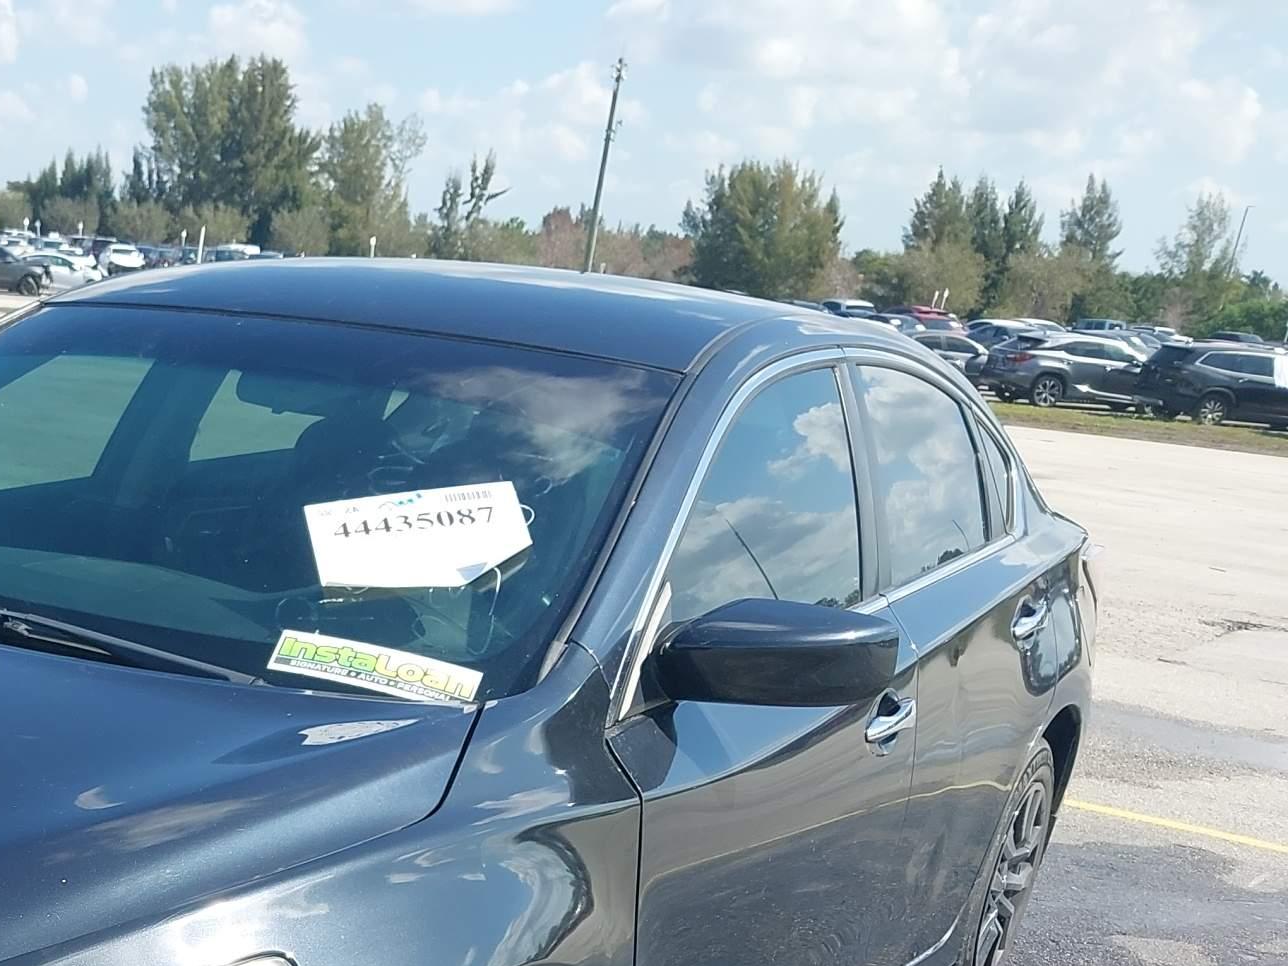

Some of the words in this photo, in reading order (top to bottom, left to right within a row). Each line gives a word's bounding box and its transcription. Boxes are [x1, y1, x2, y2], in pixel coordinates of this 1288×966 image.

[334, 506, 493, 538] 44435087
[278, 636, 475, 700] InstaLoan
[289, 659, 350, 677] SIGNATURE
[356, 671, 387, 686] AUTO
